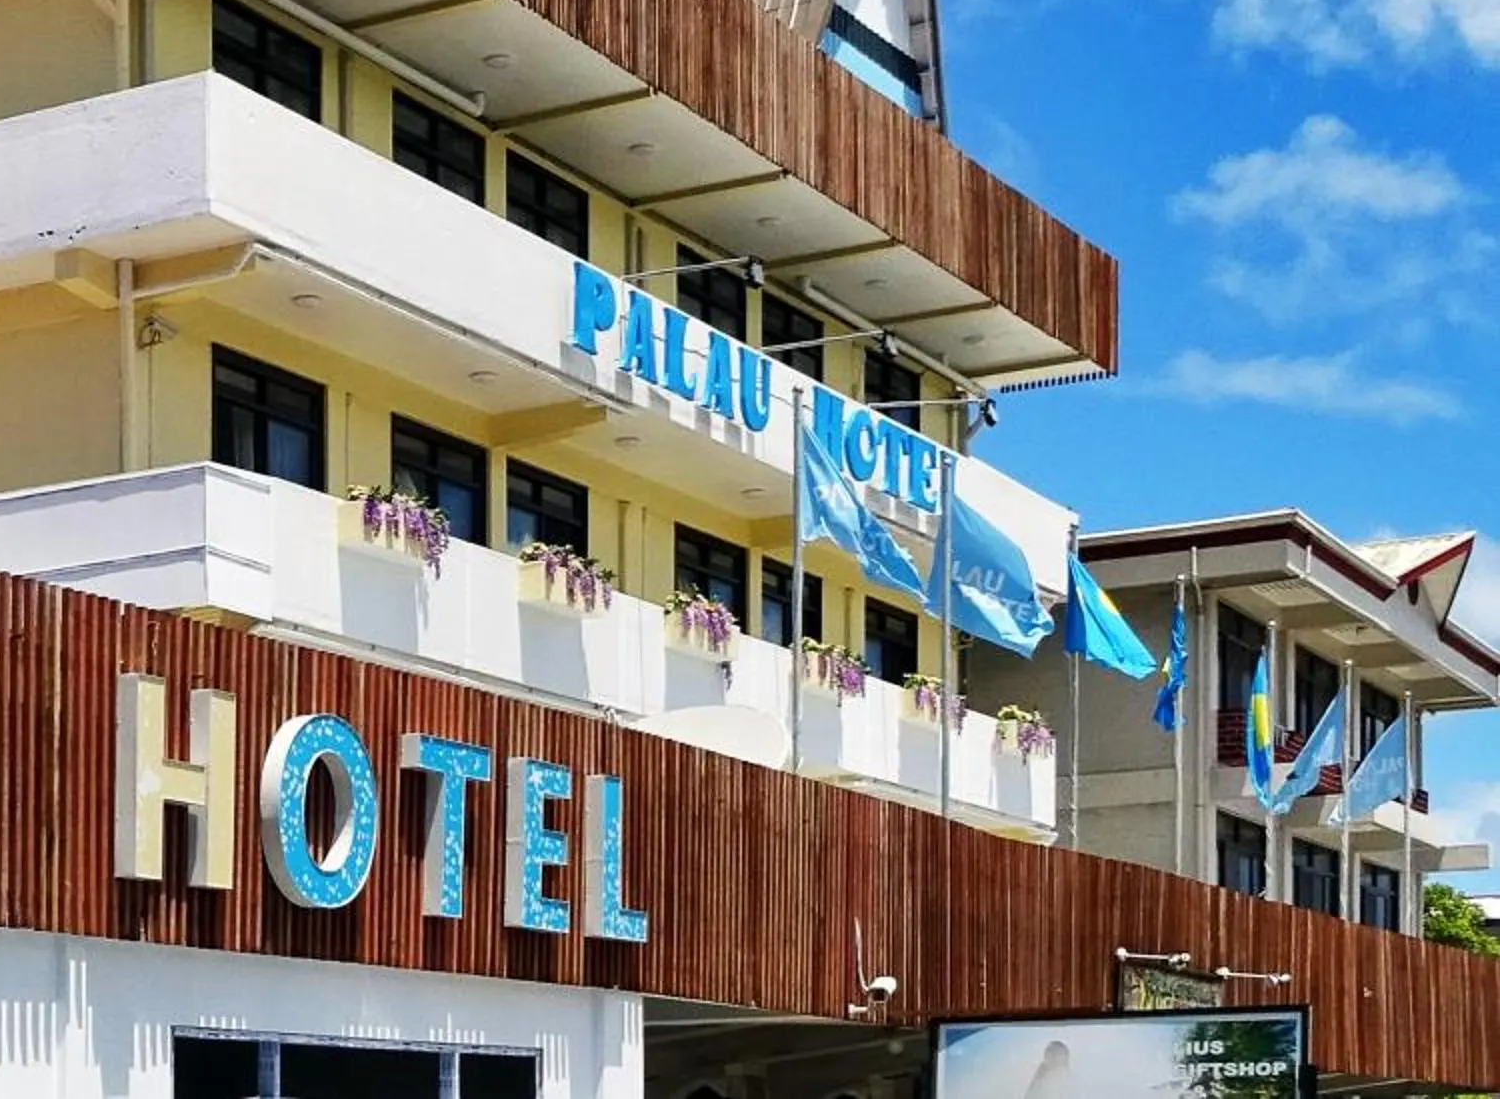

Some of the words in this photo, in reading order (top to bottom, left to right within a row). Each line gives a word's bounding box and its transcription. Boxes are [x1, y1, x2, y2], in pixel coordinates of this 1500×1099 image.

[572, 261, 772, 432] PALAU
[812, 386, 950, 515] HOTE
[952, 560, 1006, 593] LAU
[114, 672, 648, 943] HOTEL
